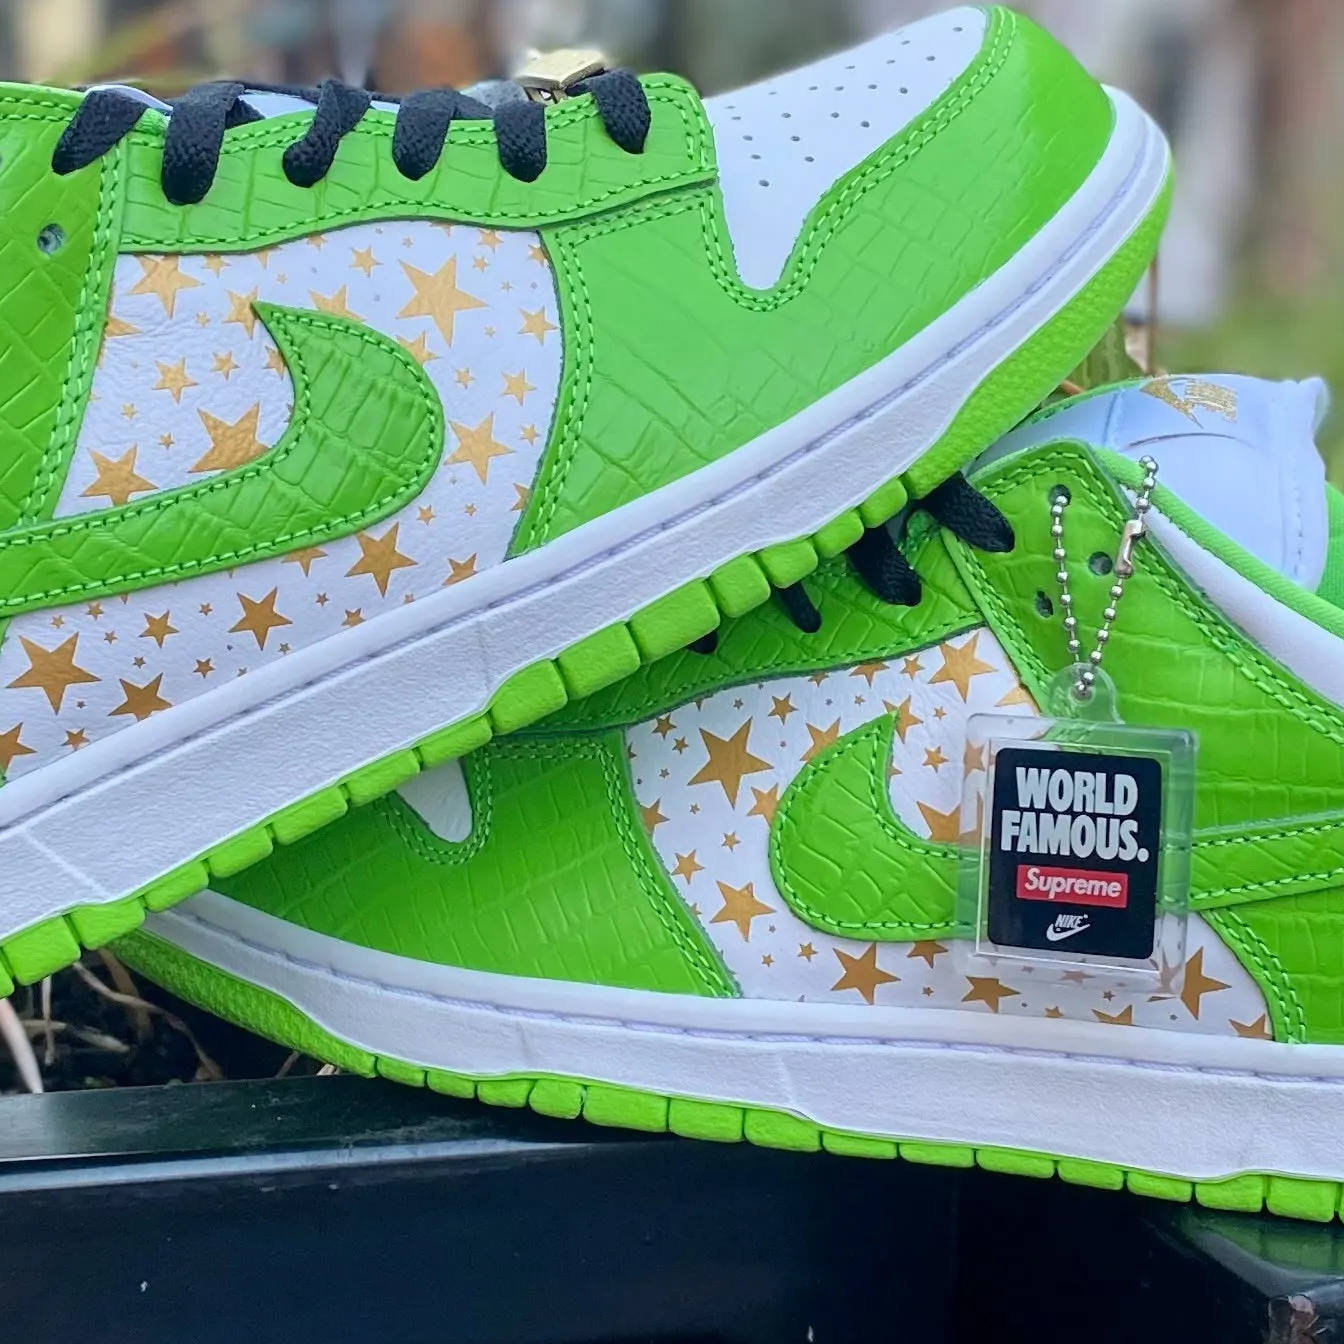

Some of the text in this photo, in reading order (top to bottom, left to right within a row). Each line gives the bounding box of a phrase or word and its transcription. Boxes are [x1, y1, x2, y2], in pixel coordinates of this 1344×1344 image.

[1015, 766, 1139, 816] WORLD
[1000, 809, 1150, 863] FAMOUS.
[1024, 867, 1122, 899] Supreme
[1054, 913, 1083, 929] NIKE
